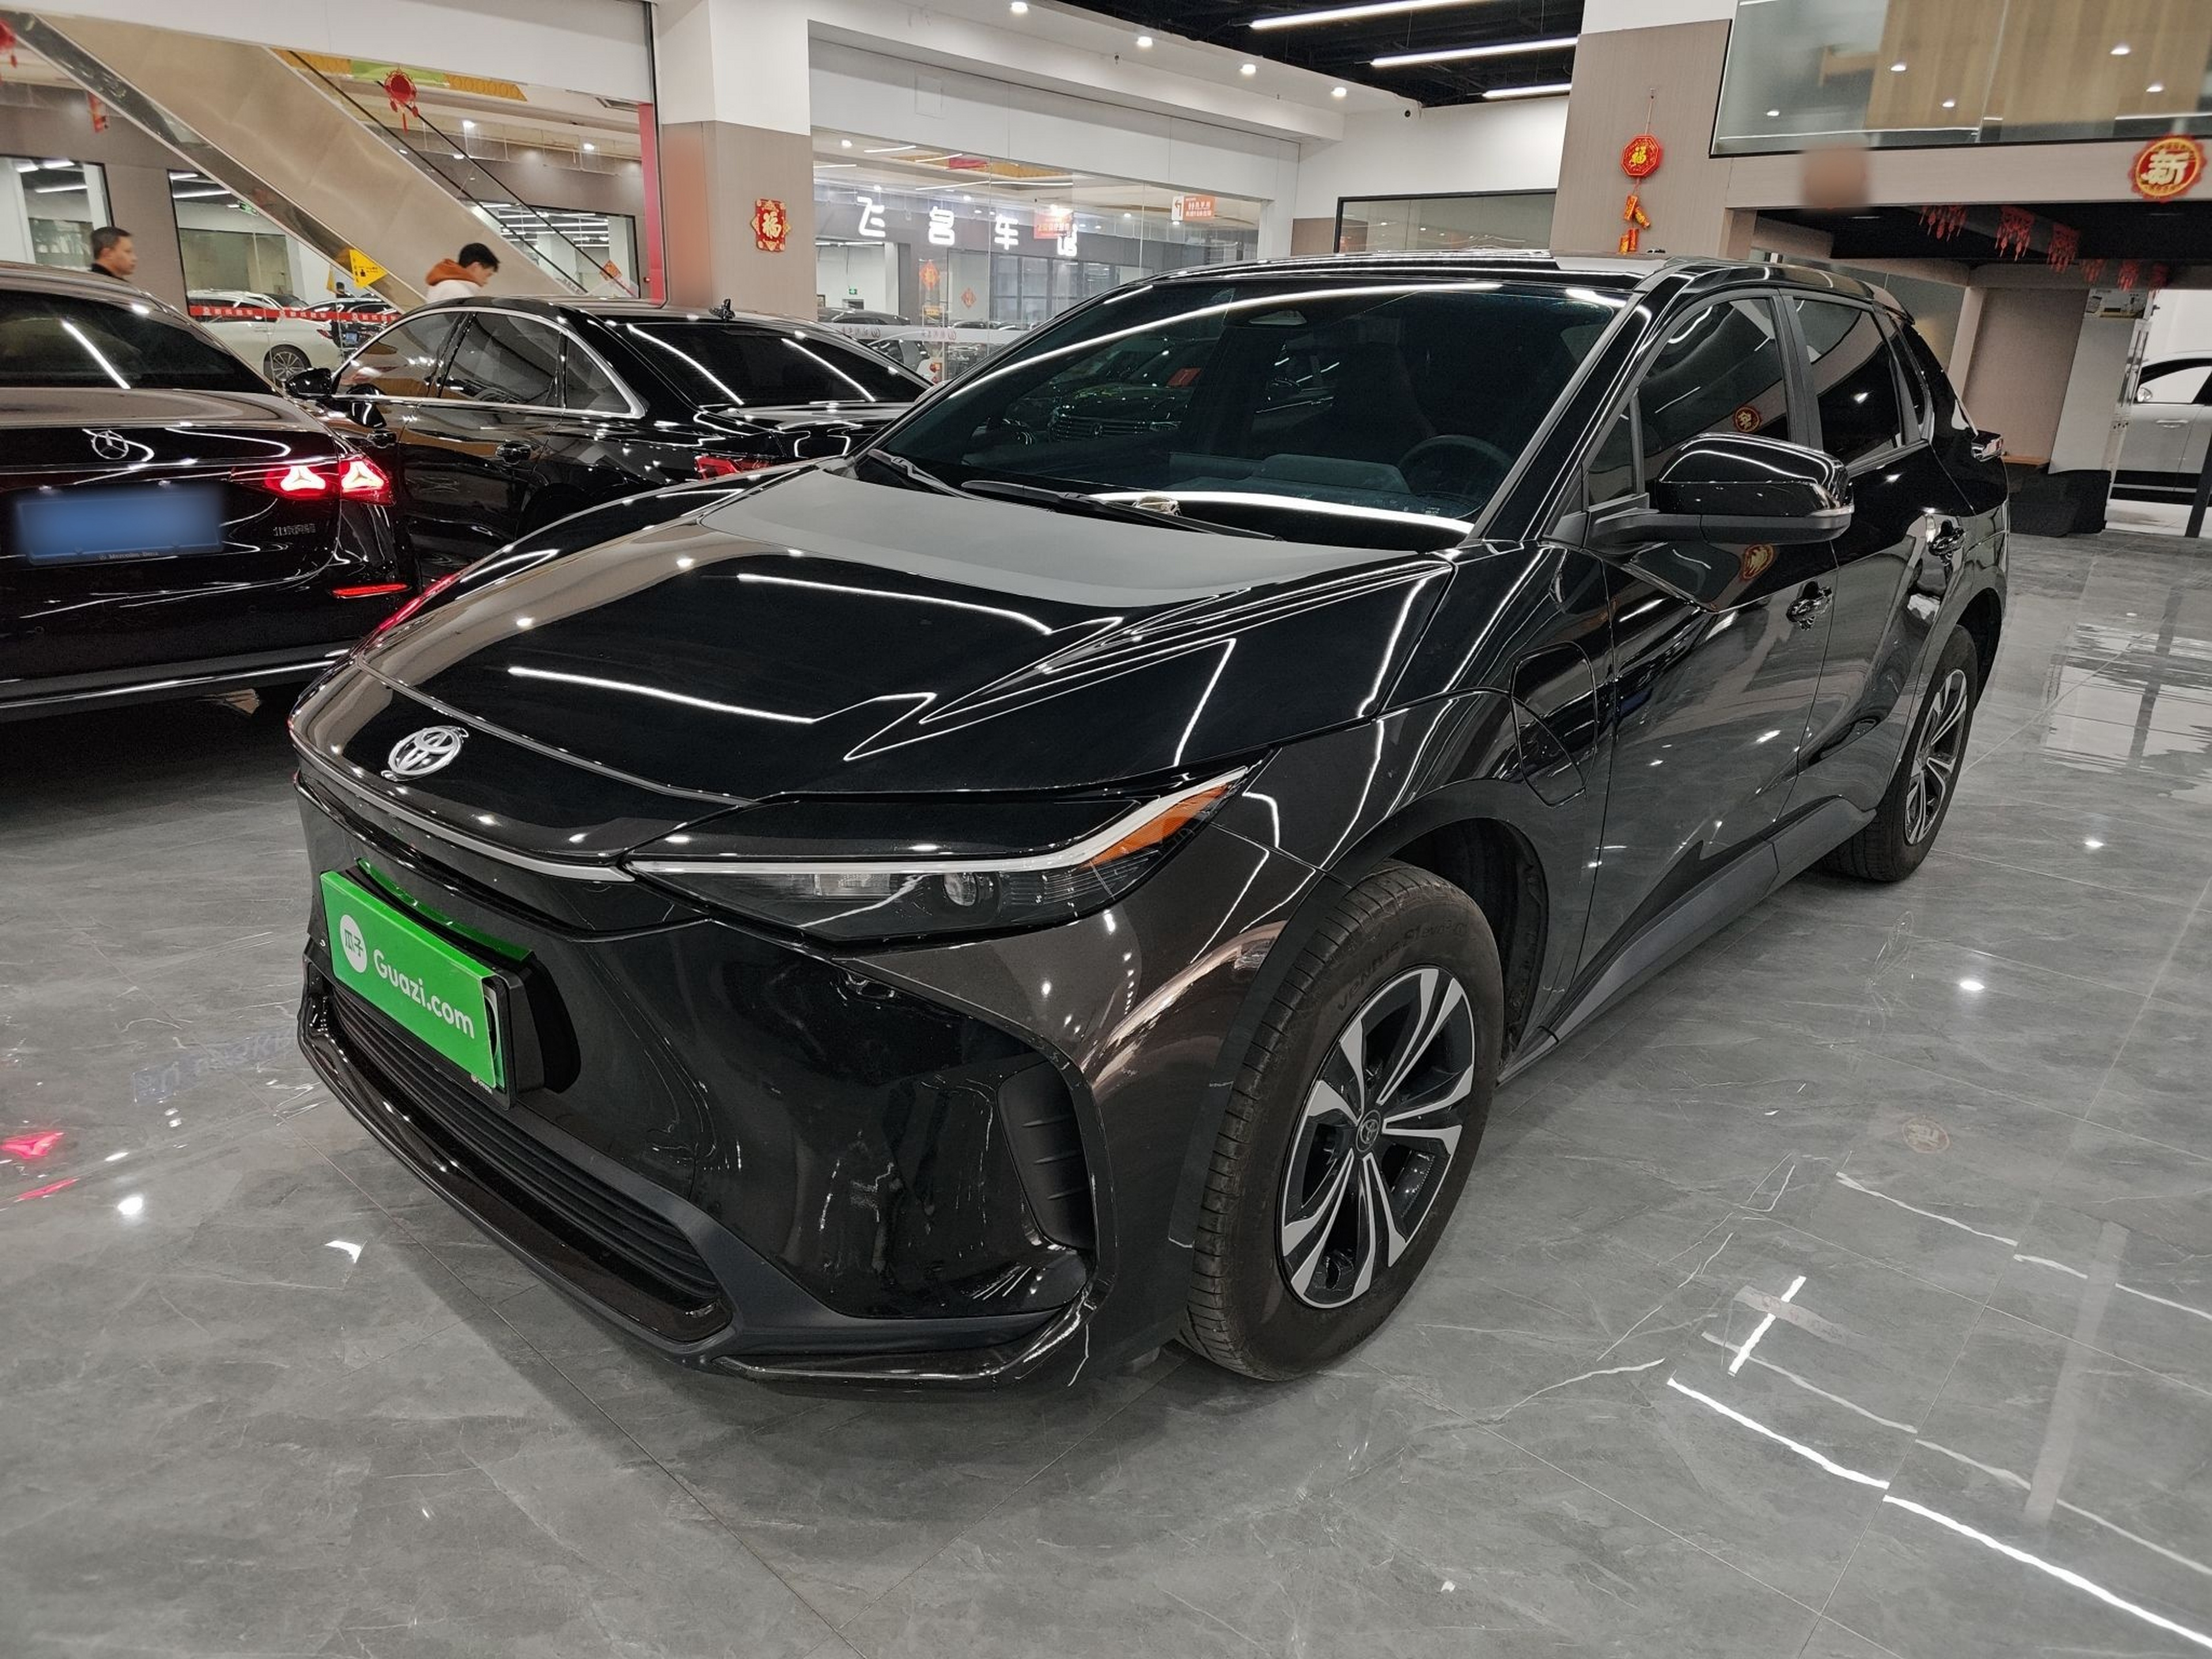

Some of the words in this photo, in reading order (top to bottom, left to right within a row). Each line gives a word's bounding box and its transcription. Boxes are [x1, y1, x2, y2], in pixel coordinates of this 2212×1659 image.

[1628, 145, 1647, 168] 福
[2141, 148, 2190, 185] 新
[762, 211, 782, 239] 福
[344, 928, 363, 958] 瓜子
[374, 949, 475, 1039] Guazi.com
